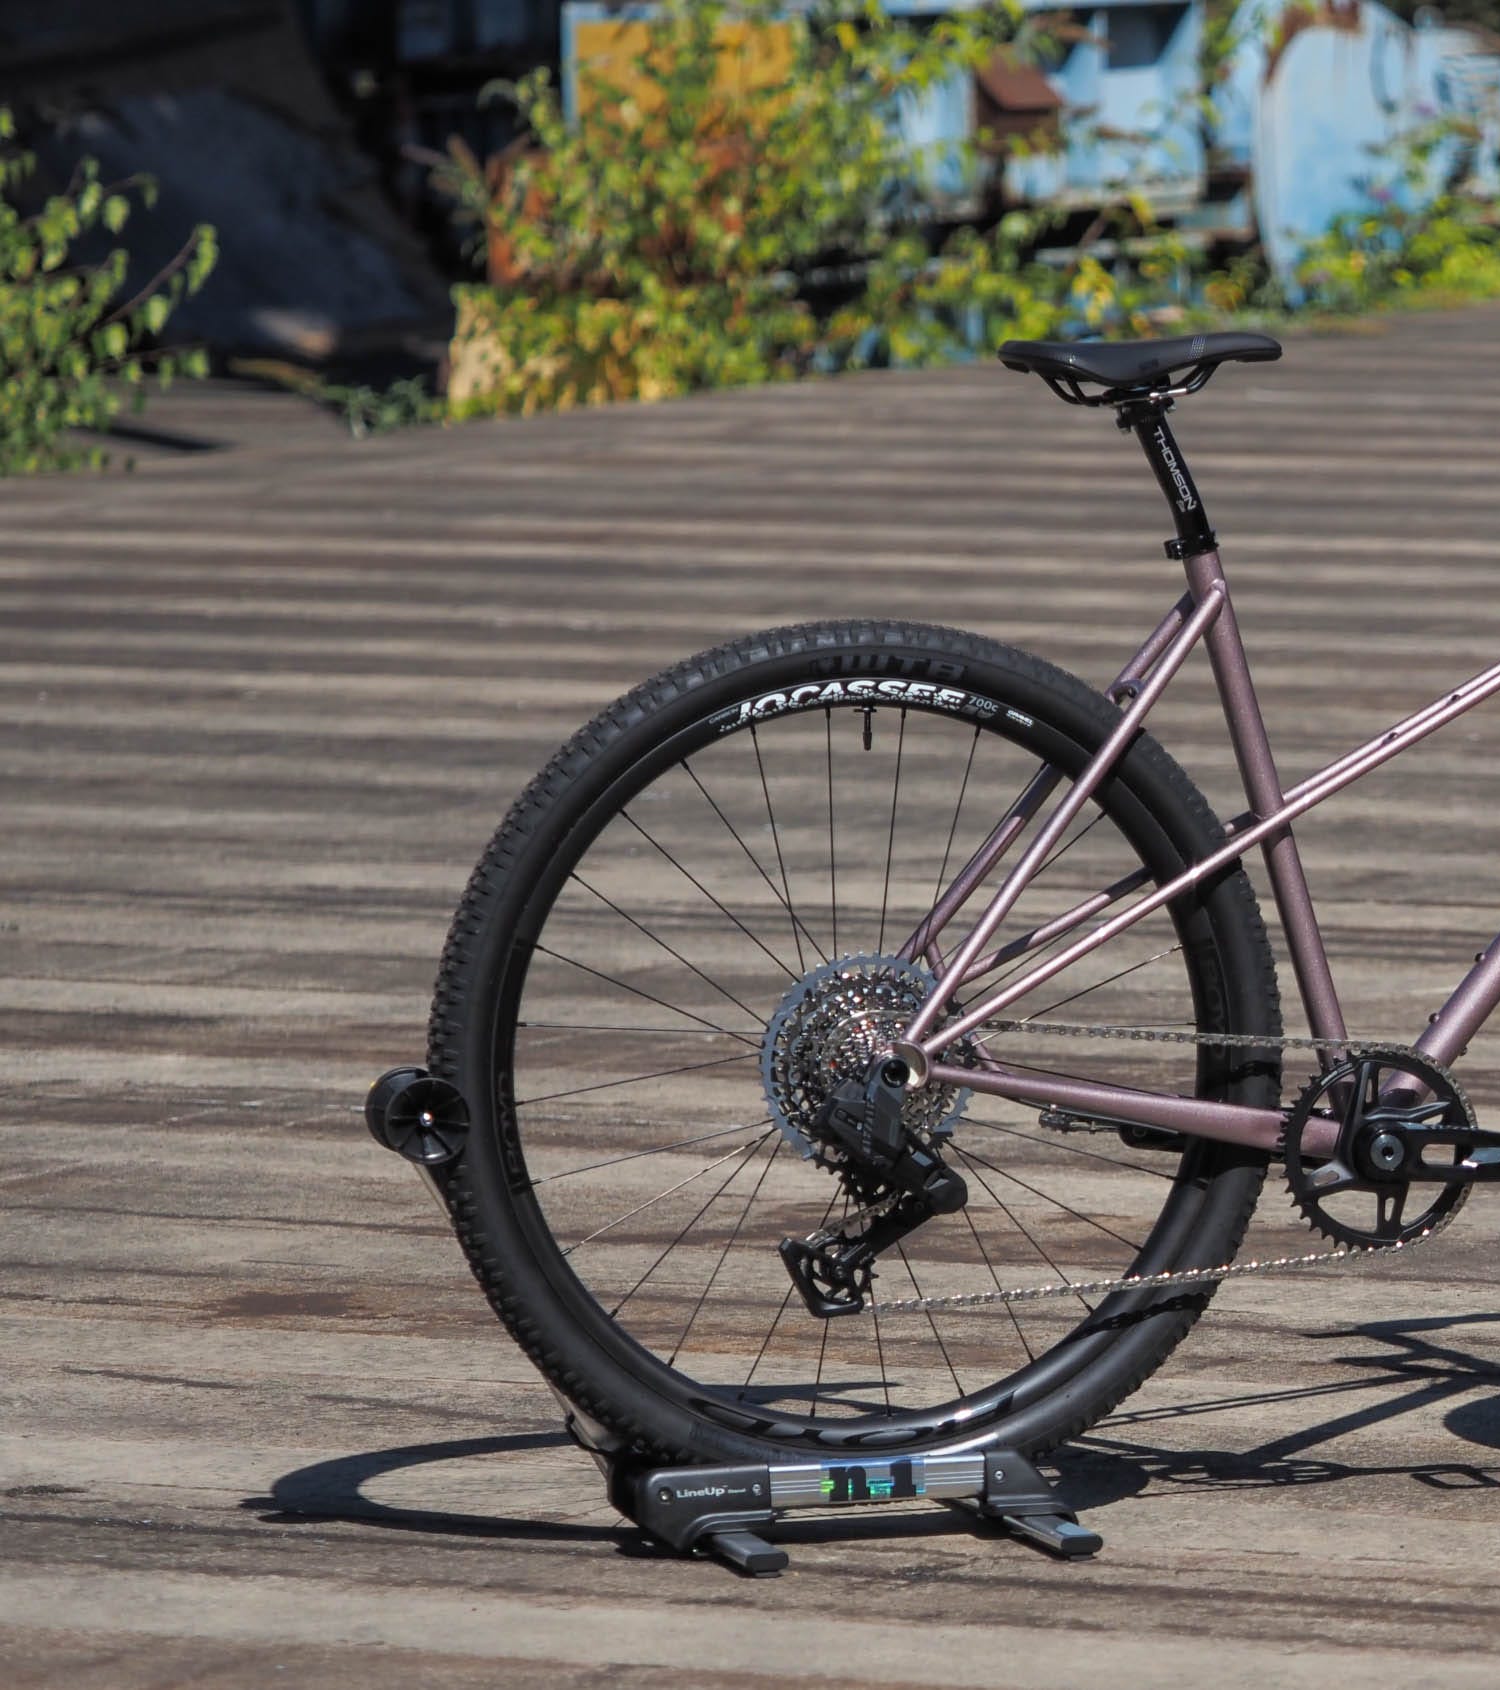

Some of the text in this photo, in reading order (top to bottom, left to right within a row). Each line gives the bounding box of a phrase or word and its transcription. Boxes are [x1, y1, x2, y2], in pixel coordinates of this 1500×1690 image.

[1153, 425, 1197, 511] THOMSON
[719, 680, 966, 732] JOCASSEE
[967, 695, 999, 712] 700c
[676, 1486, 726, 1499] LineUp
